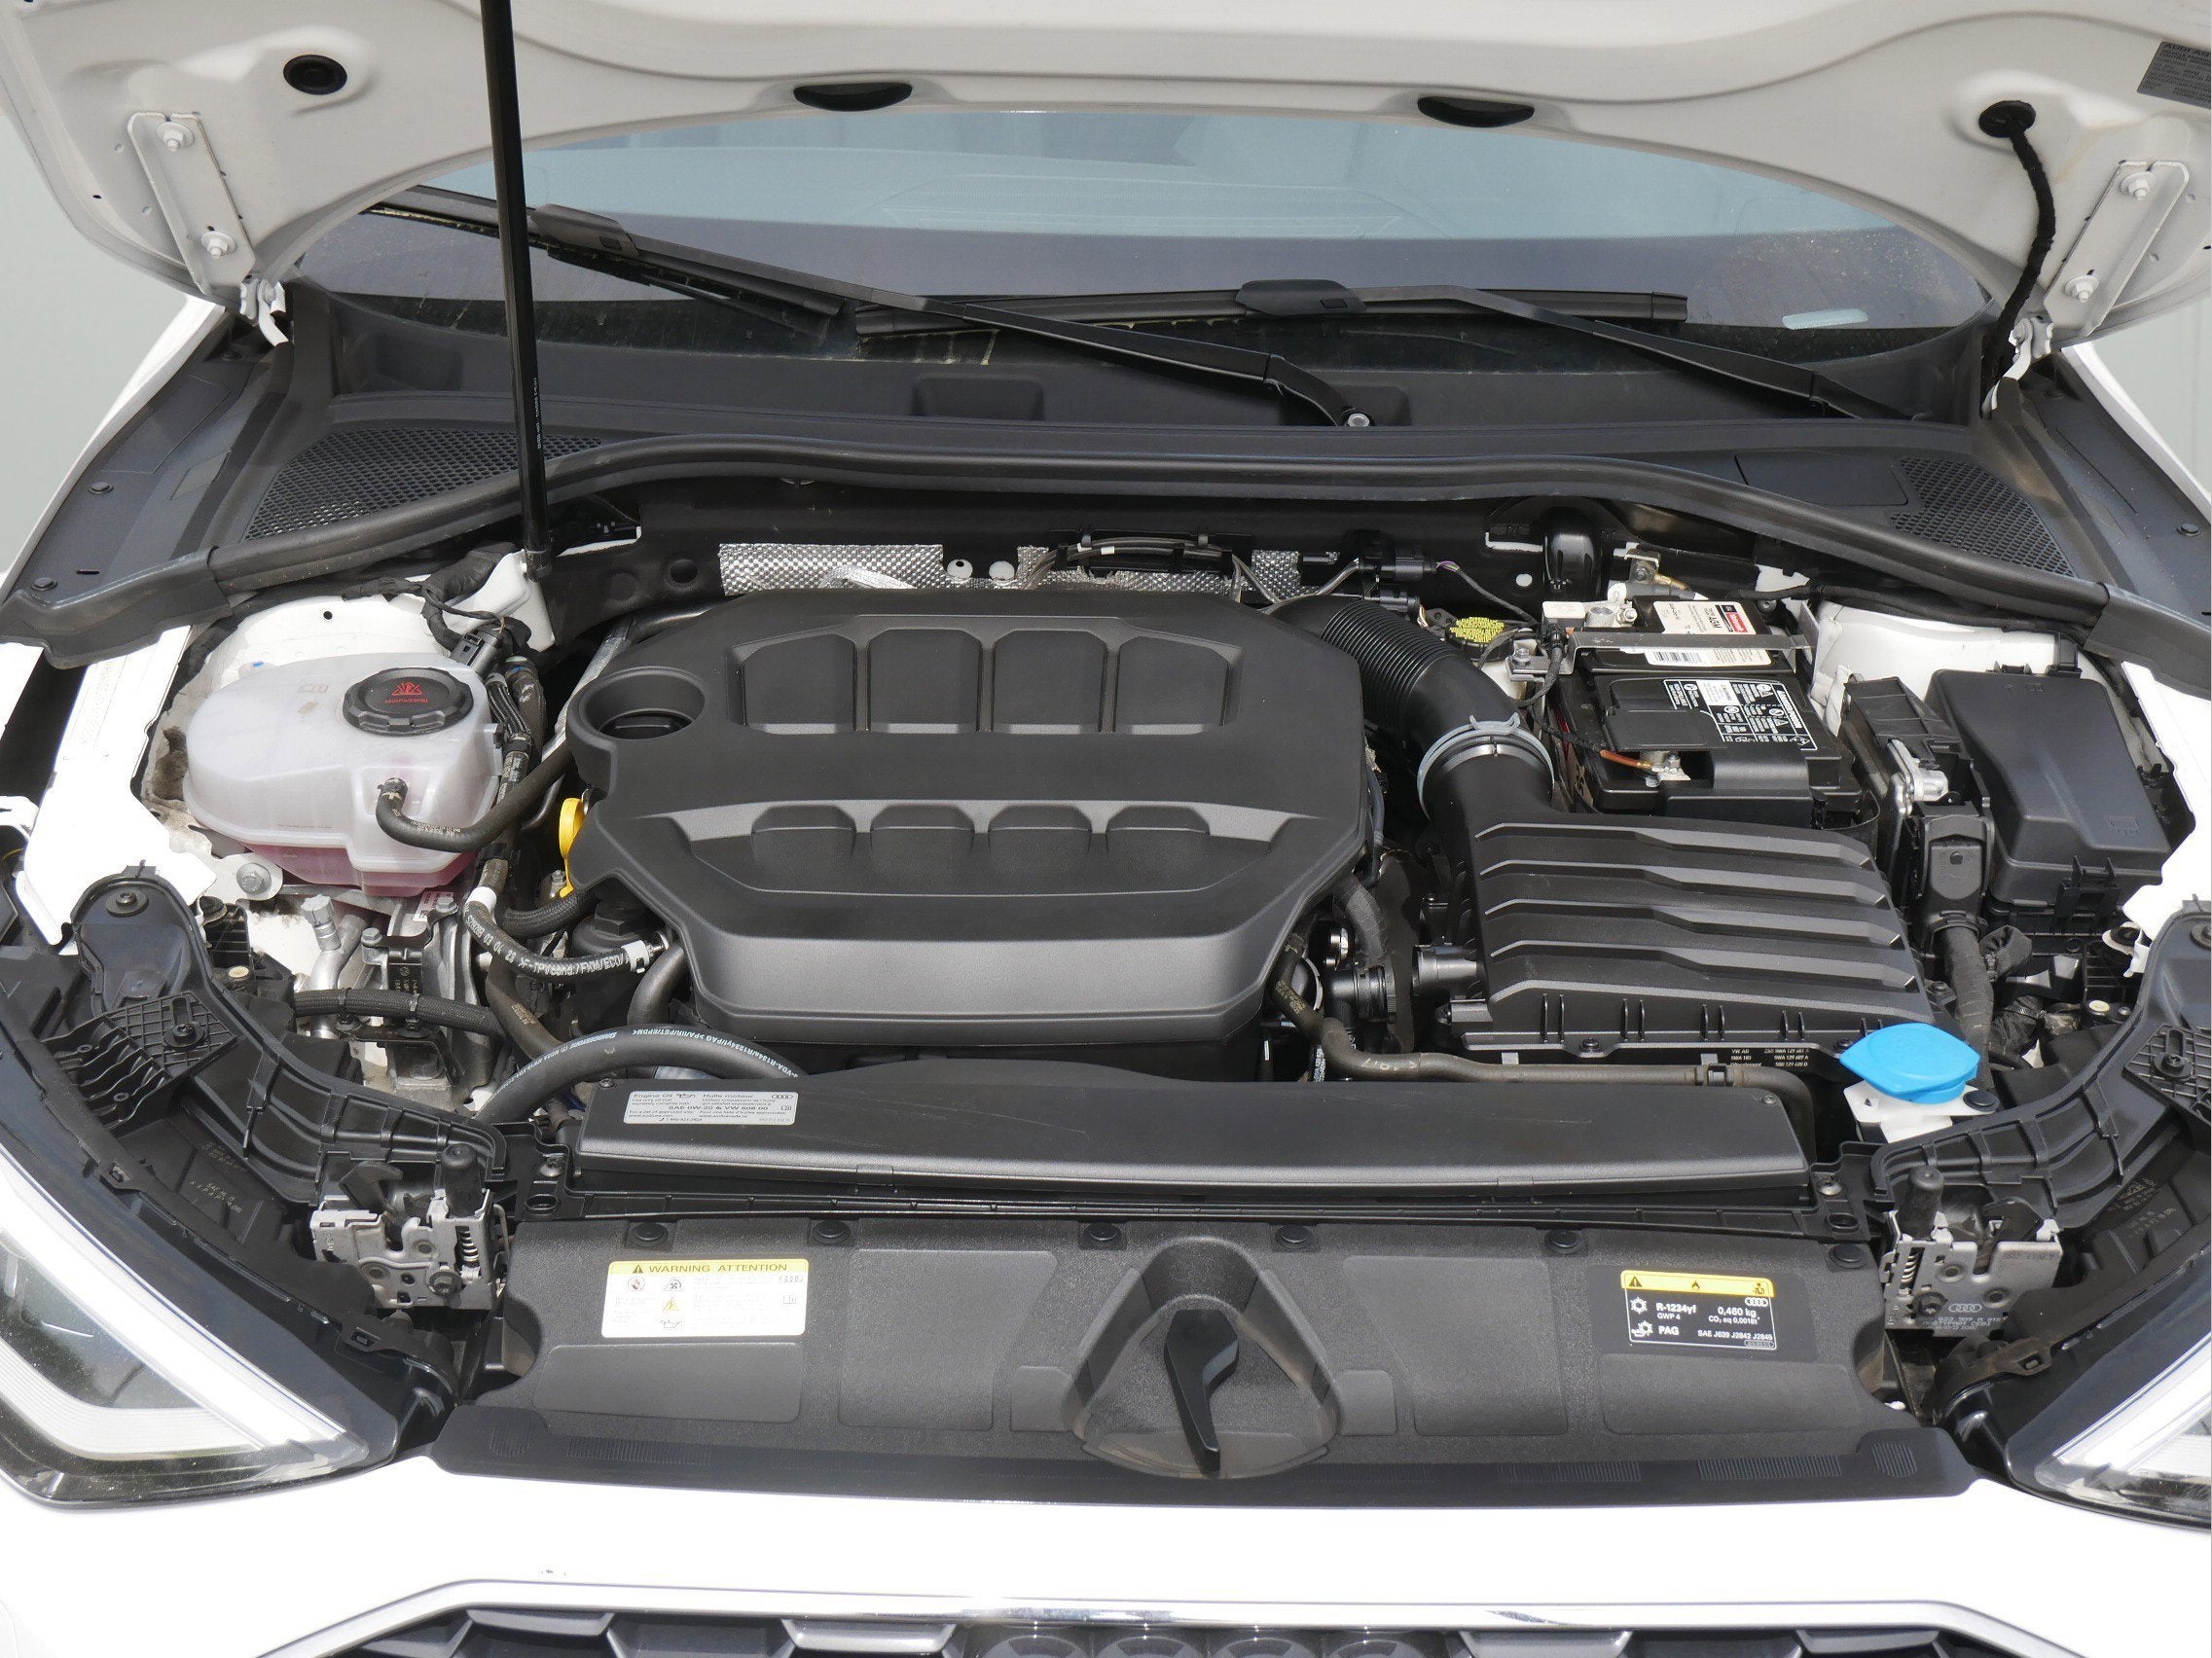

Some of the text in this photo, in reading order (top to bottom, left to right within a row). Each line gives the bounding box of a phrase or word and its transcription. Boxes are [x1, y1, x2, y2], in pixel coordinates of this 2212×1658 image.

[649, 1263, 787, 1273] WARNING ATTENTION
[1656, 1302, 1697, 1315] R-1234yf
[1744, 1307, 1757, 1318] kg
[1658, 1325, 1679, 1336] PAG
